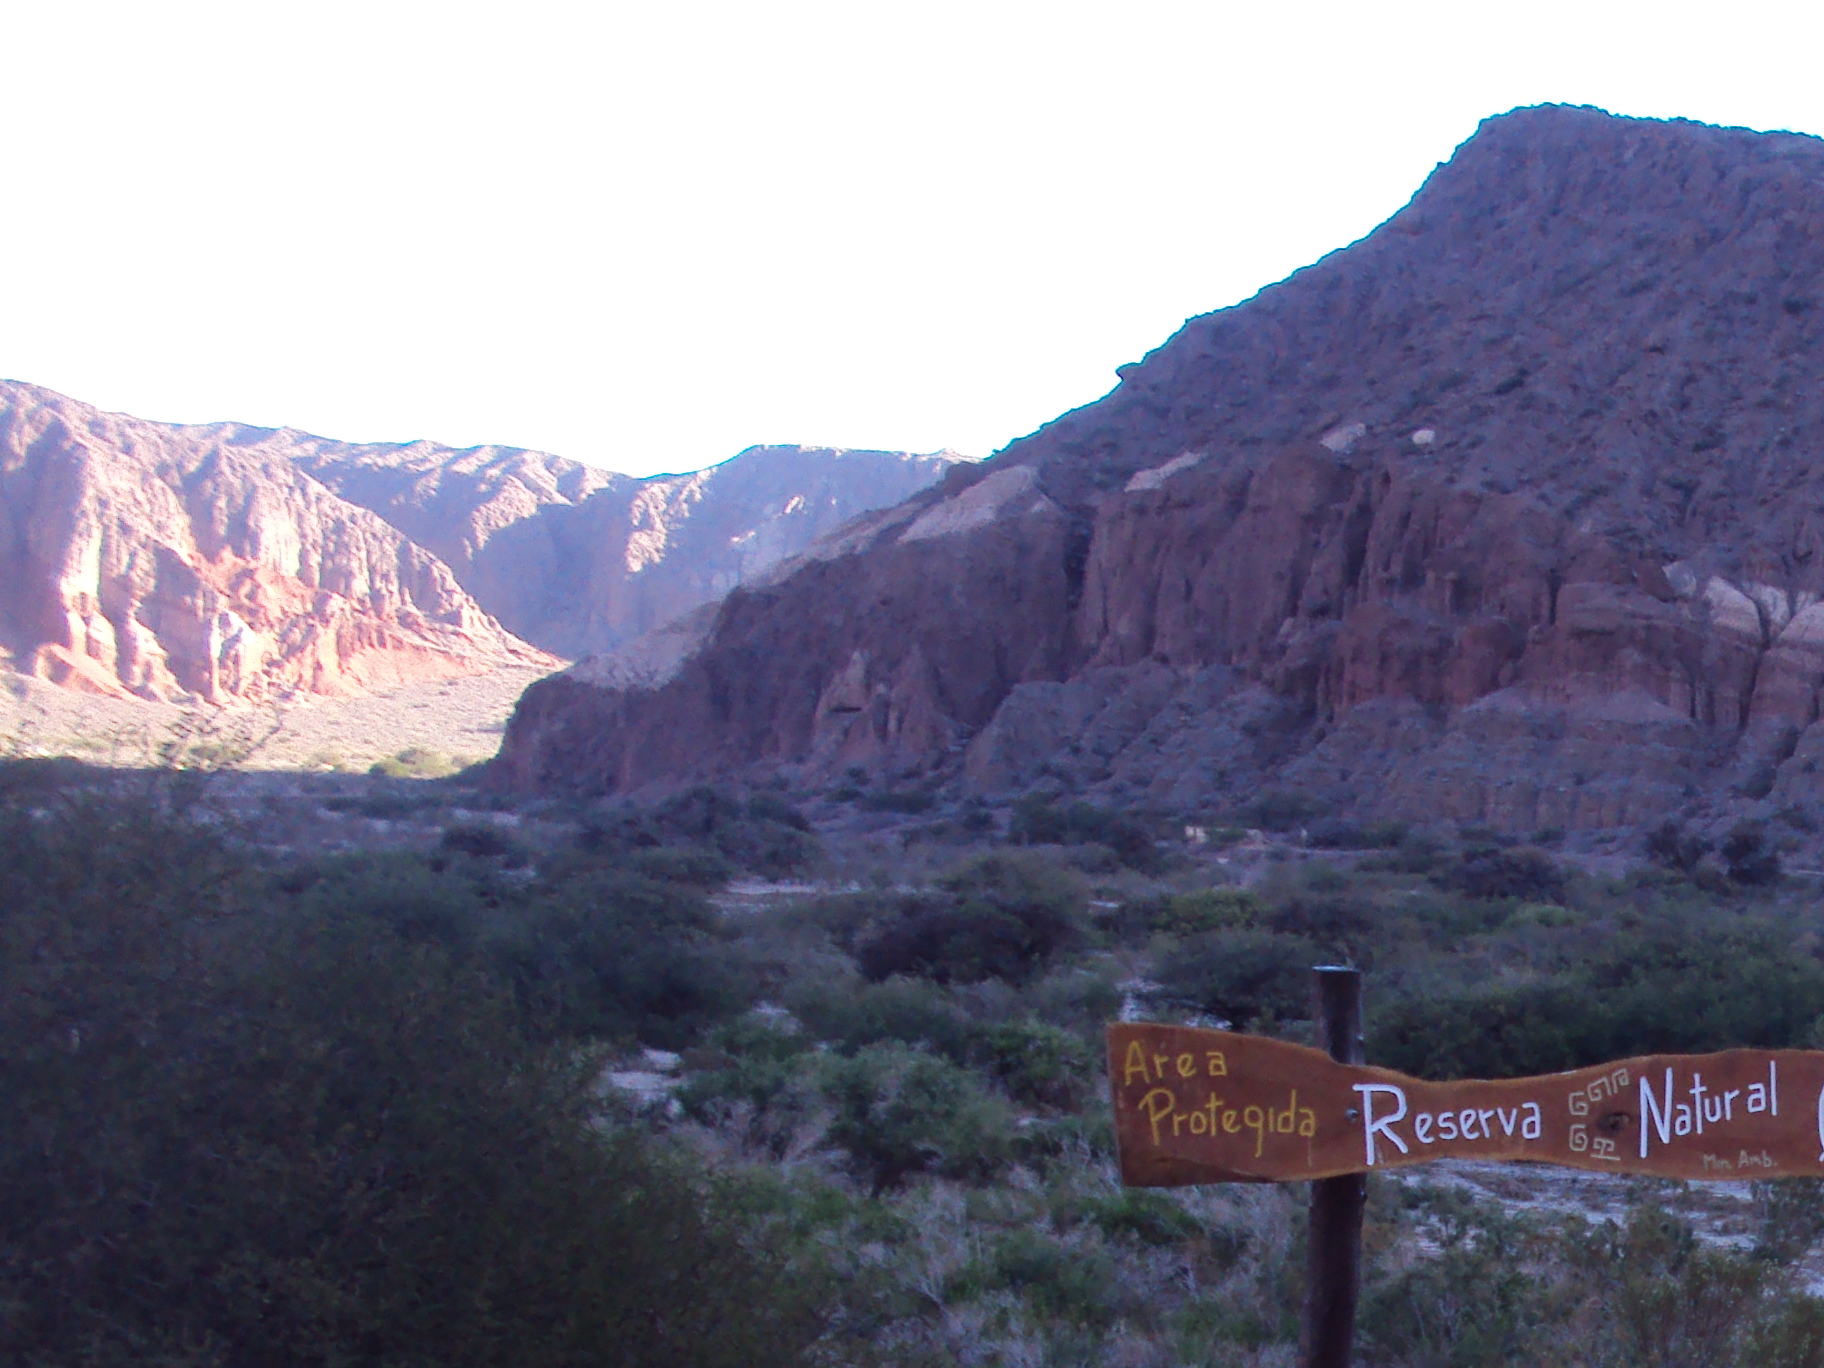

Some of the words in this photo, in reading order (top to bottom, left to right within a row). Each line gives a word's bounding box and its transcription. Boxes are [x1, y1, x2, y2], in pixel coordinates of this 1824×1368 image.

[1124, 1040, 1228, 1087] Area
[1137, 1087, 1317, 1158] Protegida
[1351, 1082, 1542, 1167] Reserva
[1639, 1060, 1778, 1159] Natural
